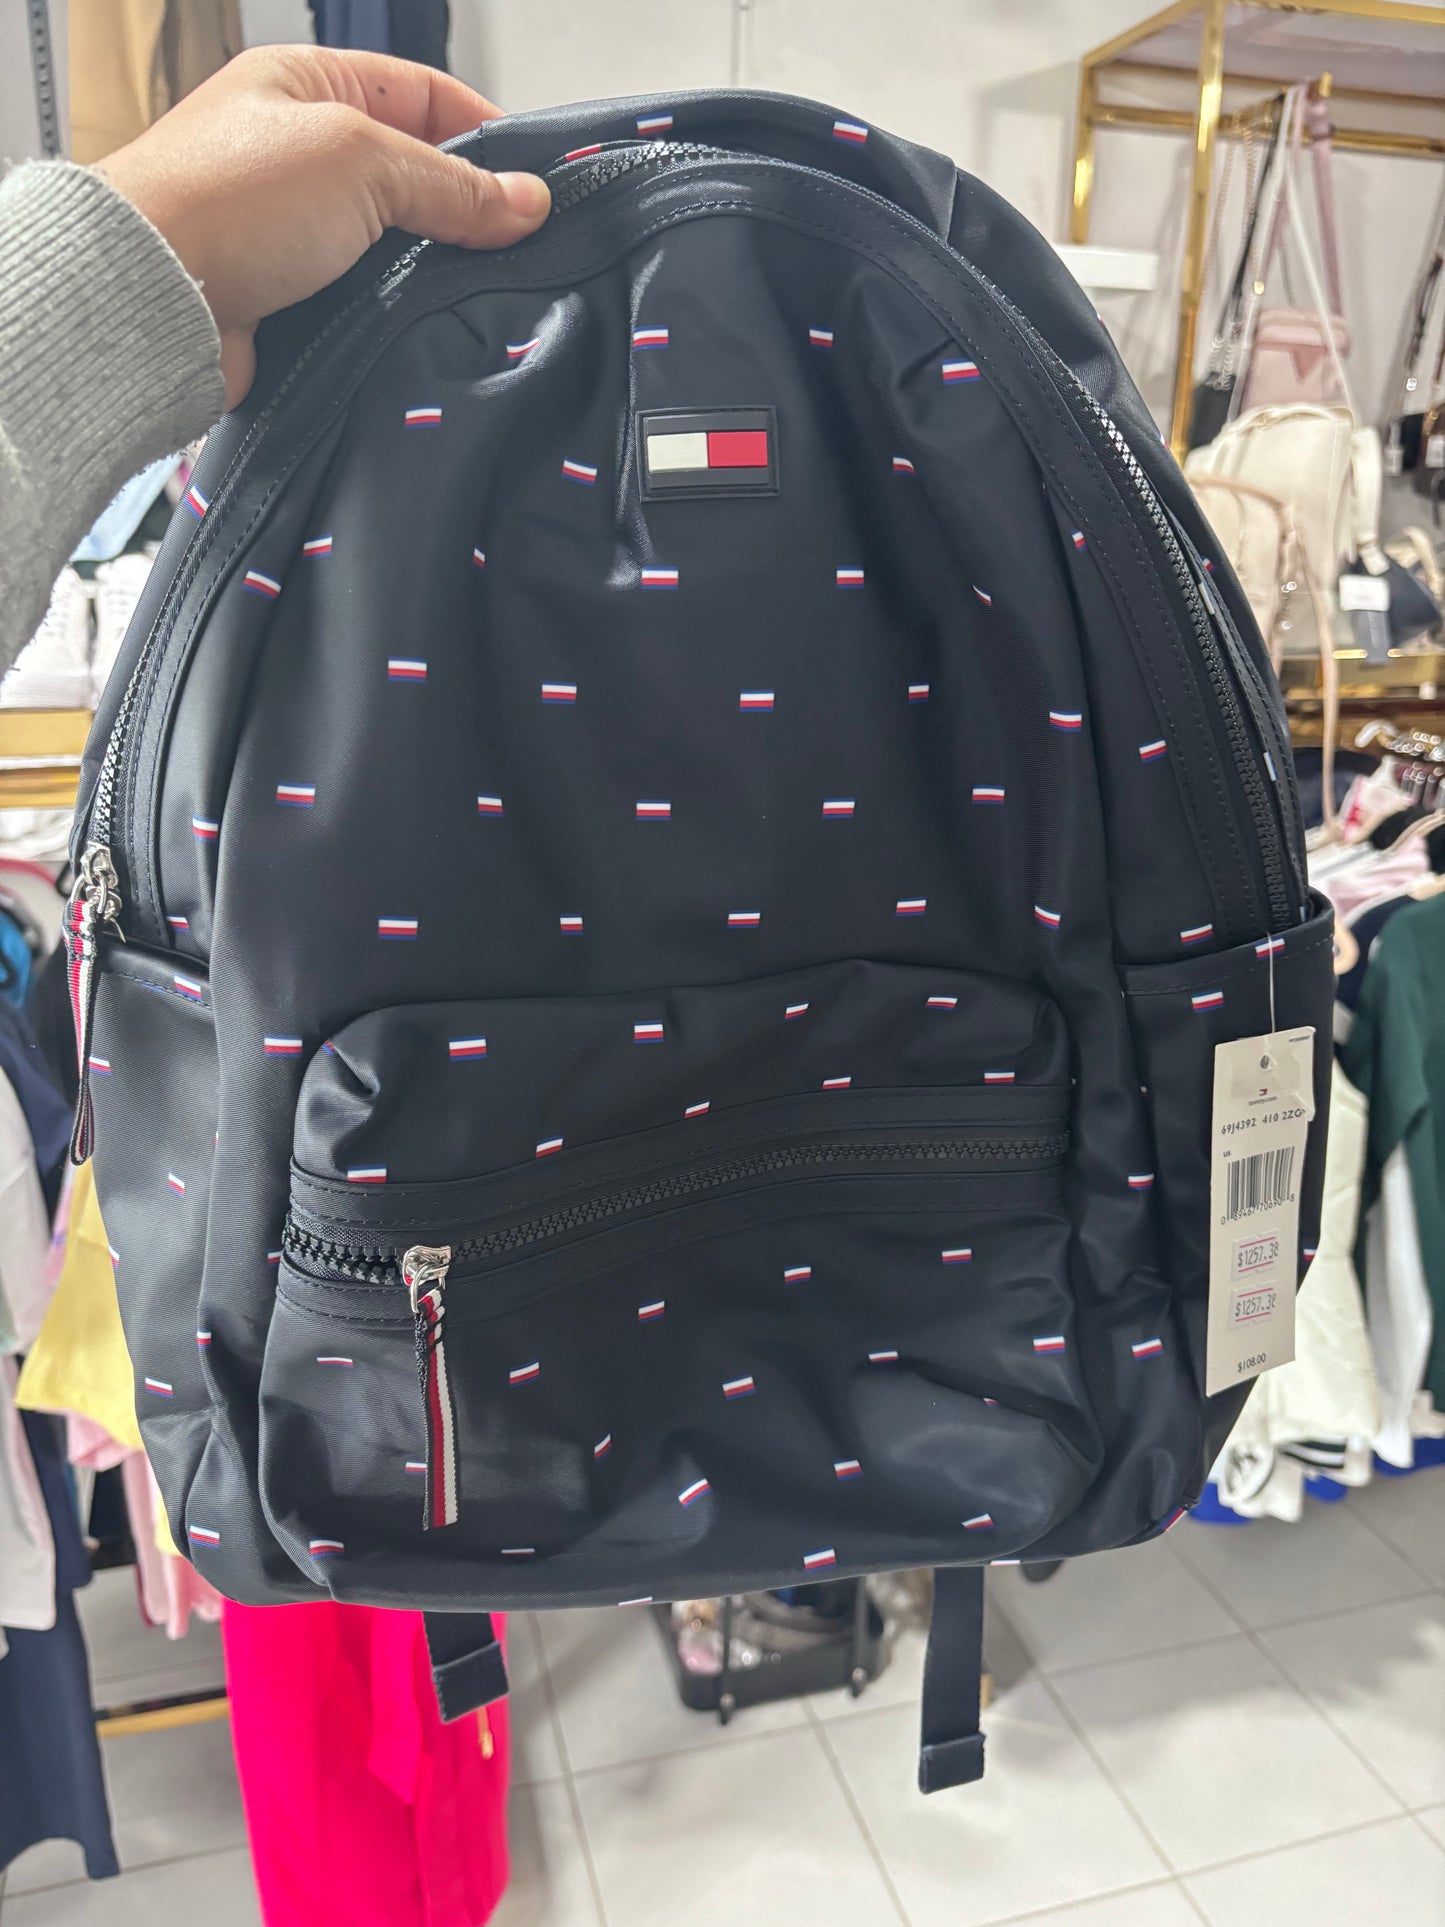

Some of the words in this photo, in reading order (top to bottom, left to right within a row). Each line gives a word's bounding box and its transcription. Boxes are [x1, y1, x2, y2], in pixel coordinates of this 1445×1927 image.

[1221, 1118, 1256, 1135] 69J4392
[1262, 1113, 1278, 1124] 410
[1237, 1352, 1266, 1373] $108.00
